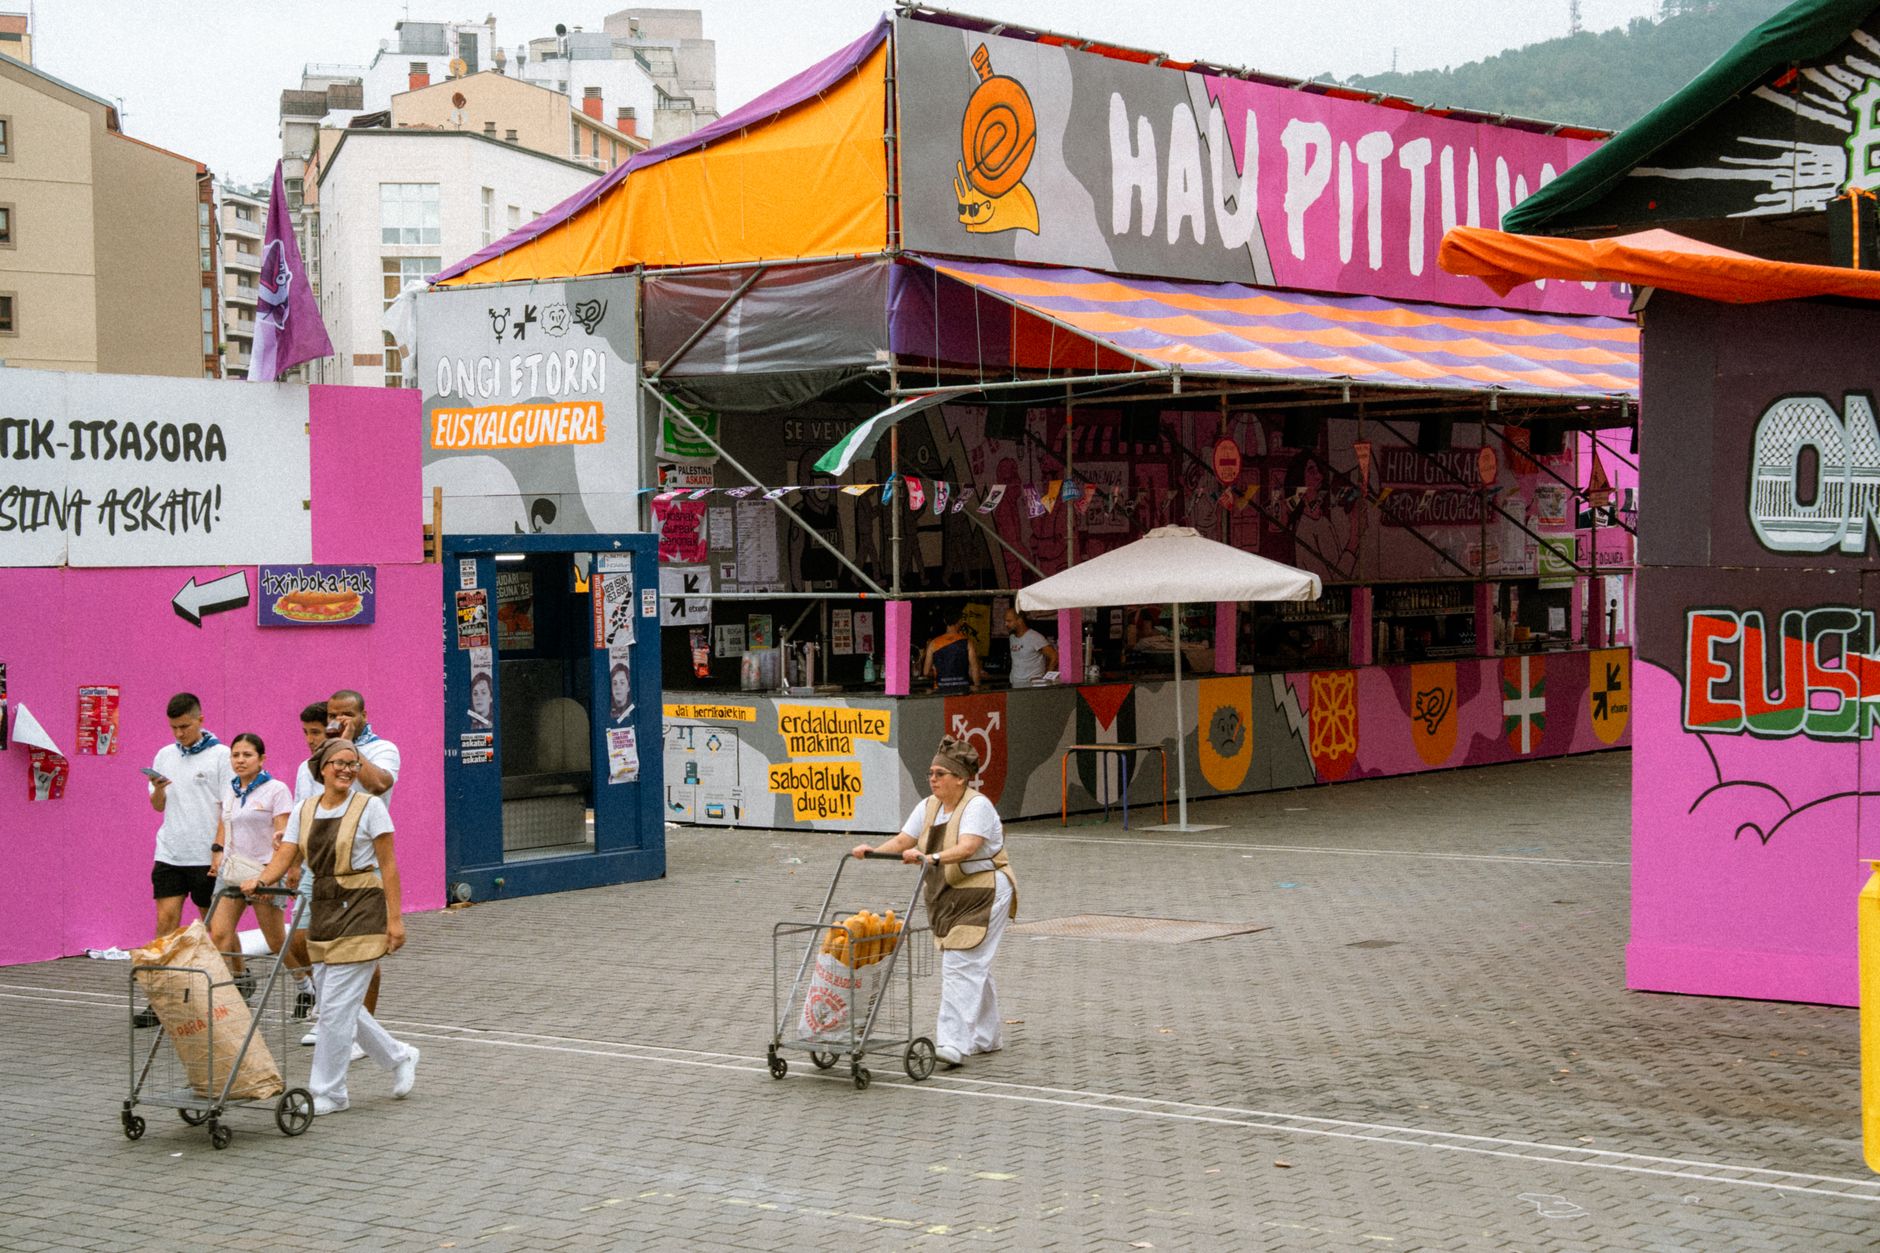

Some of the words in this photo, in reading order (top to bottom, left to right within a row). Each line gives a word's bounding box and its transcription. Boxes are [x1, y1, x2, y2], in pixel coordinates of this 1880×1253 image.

[1109, 92, 1259, 249] HAU
[437, 355, 501, 398] ONGI
[510, 347, 606, 398] ETORRI
[435, 405, 598, 447] EUSKALGUNERA
[678, 466, 712, 476] PALESTINA
[262, 569, 373, 595] txinbokatak
[694, 706, 747, 720] herrikoiekin
[780, 708, 885, 736] erdalduntze
[790, 733, 851, 753] makina
[796, 792, 853, 818] dugu!!
